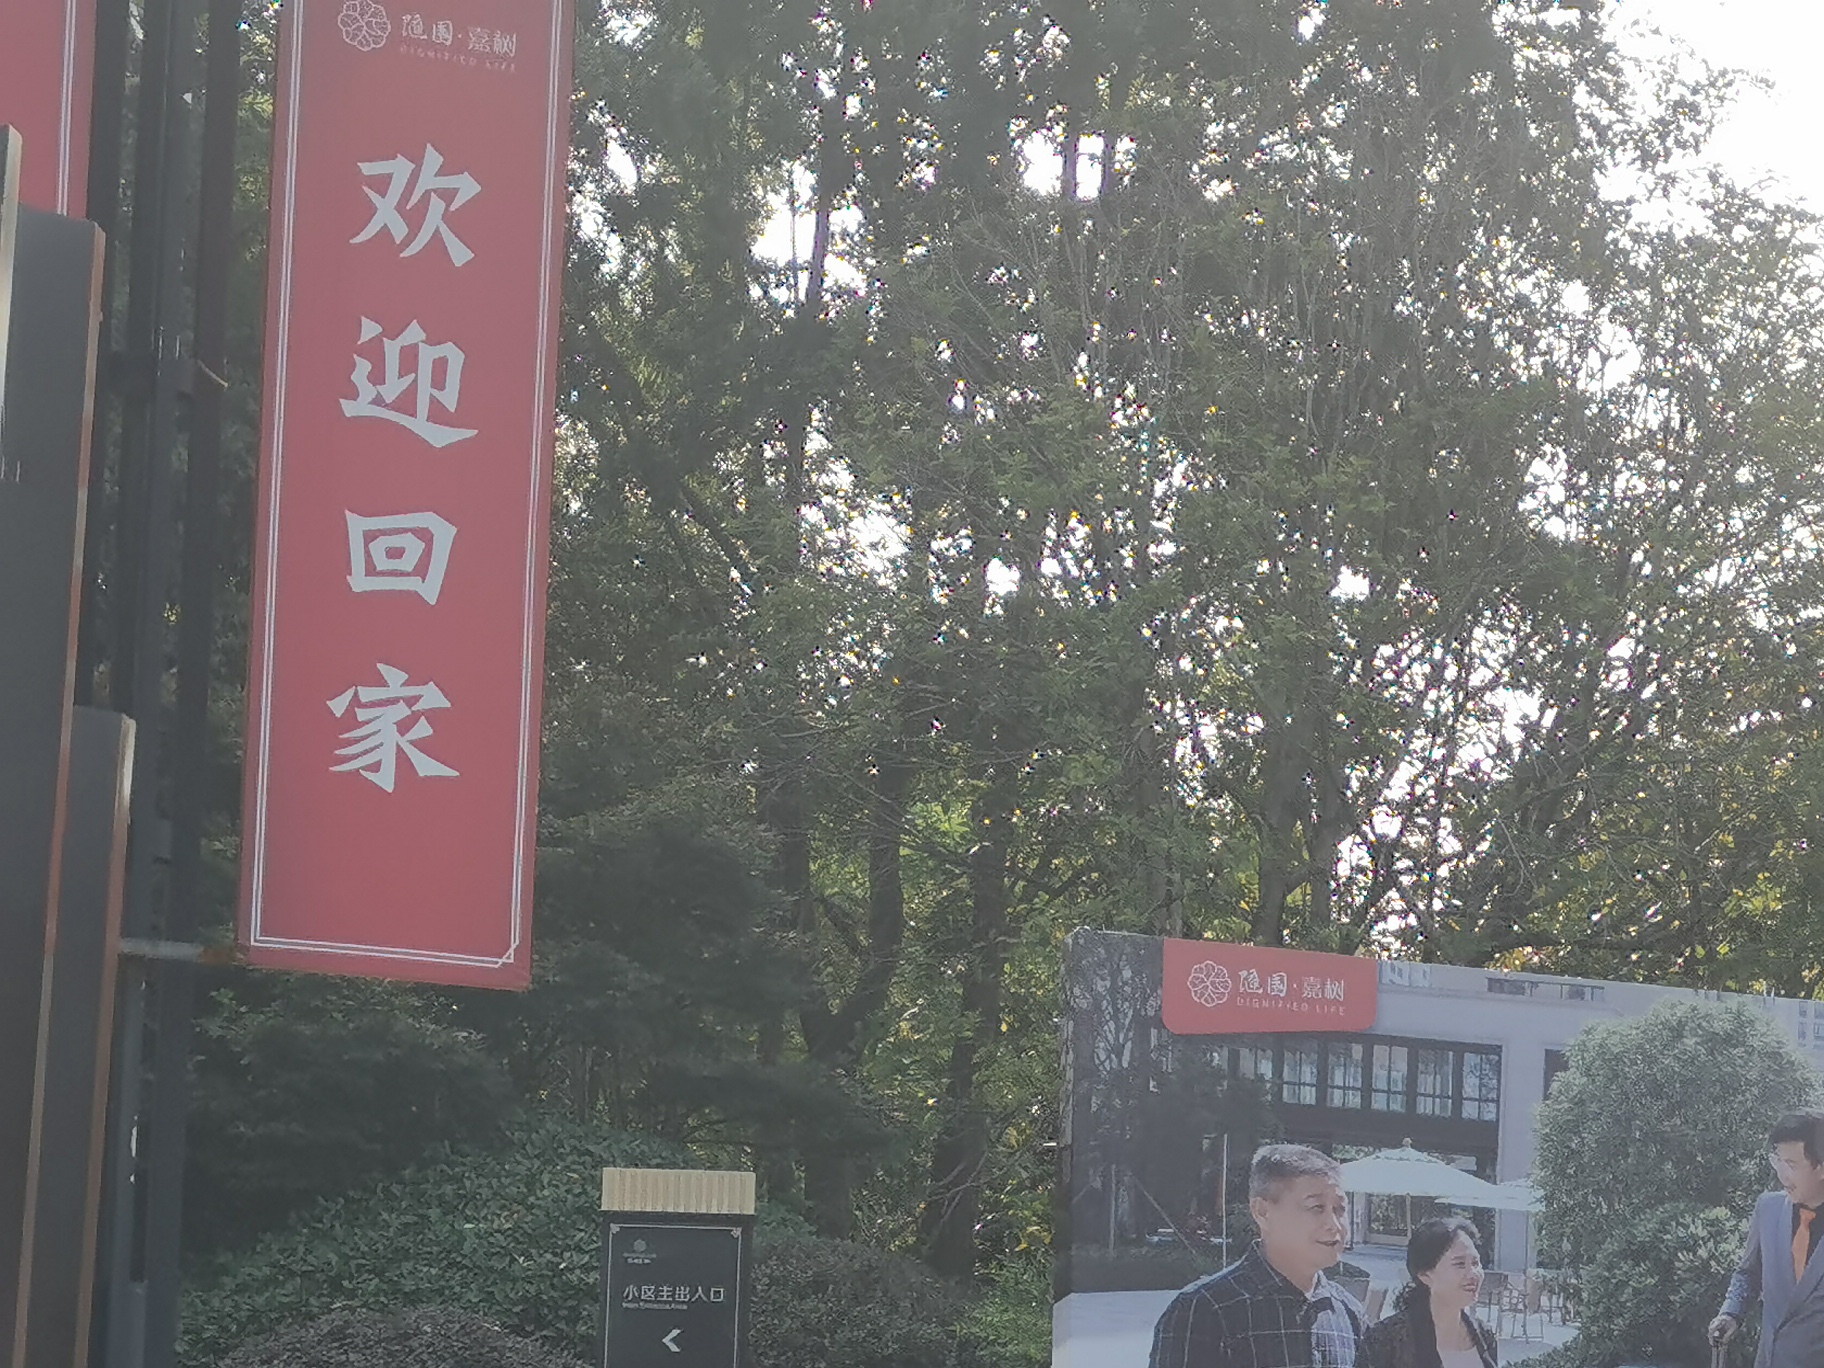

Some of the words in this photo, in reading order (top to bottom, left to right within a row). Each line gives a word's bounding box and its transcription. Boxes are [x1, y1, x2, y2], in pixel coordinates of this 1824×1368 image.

[326, 143, 482, 793] 欢迎回家
[622, 1283, 725, 1303] 小区主出入口
